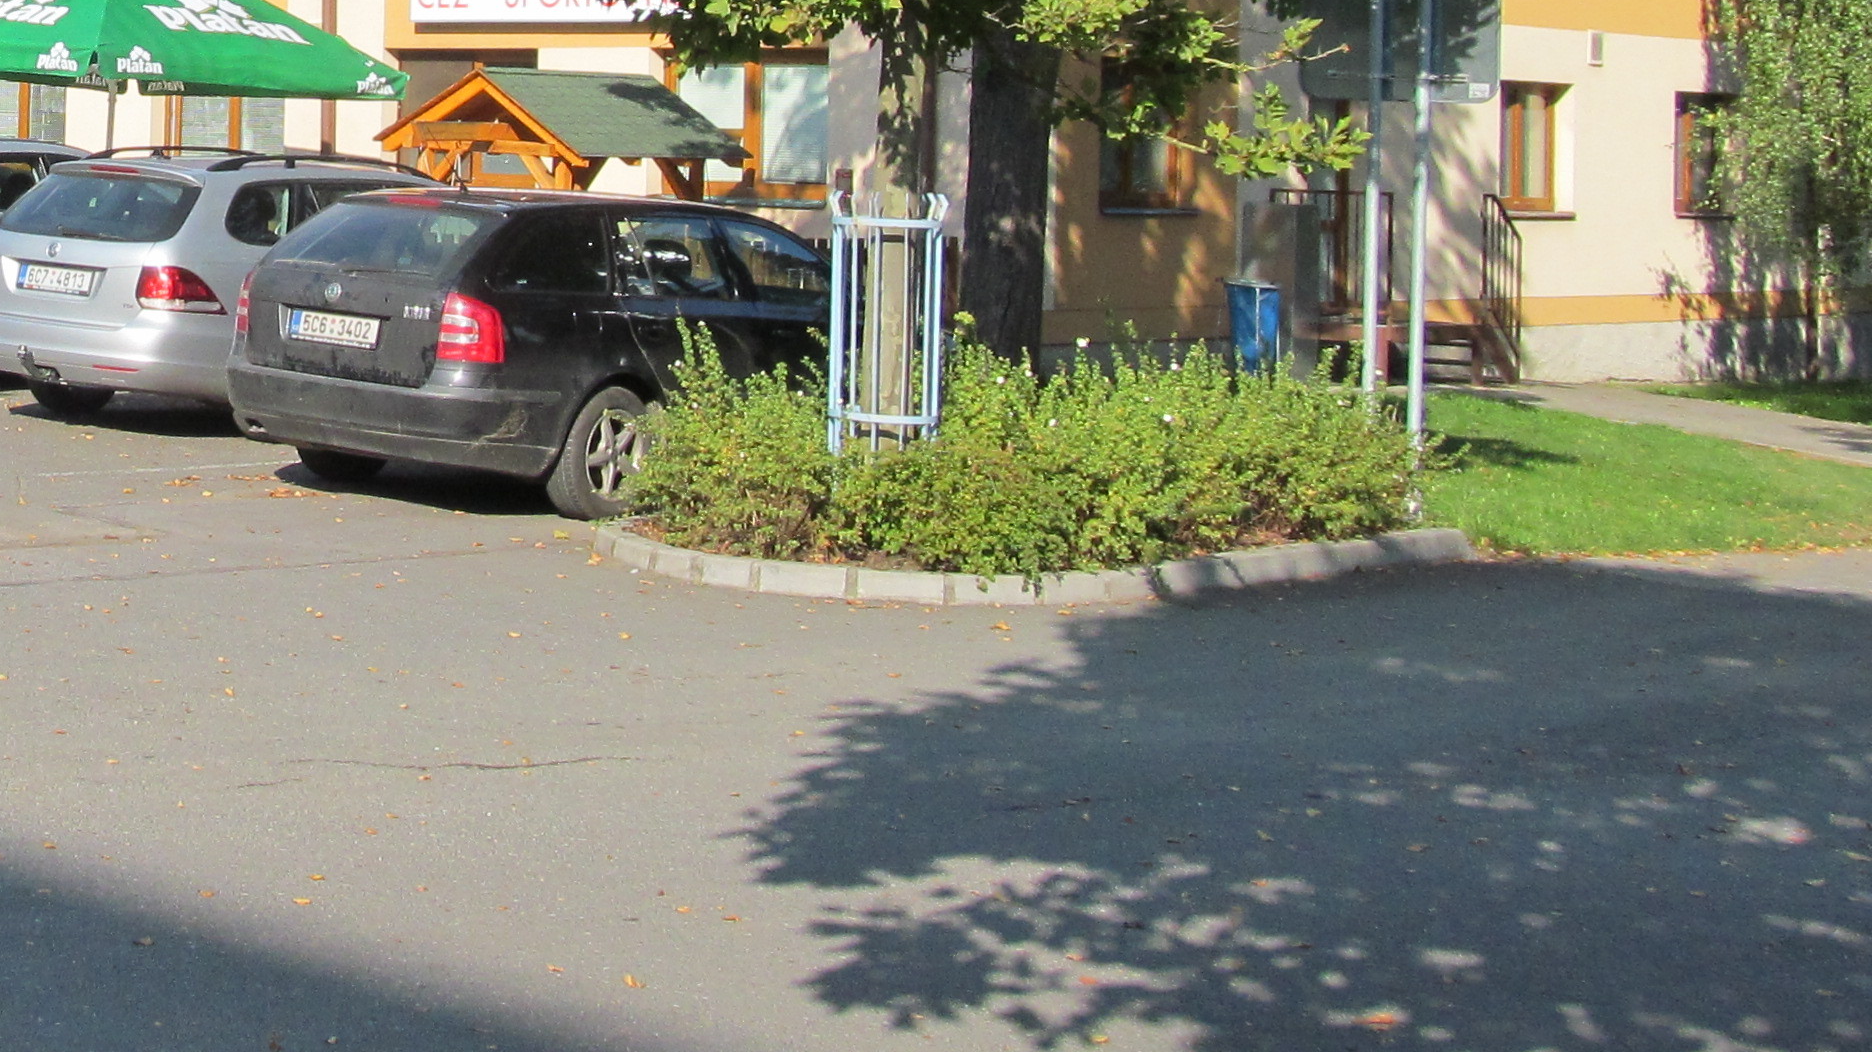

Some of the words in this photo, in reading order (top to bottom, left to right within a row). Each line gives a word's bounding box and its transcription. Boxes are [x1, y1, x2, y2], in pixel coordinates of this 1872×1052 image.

[143, 4, 315, 46] Platan
[36, 53, 78, 72] Platan
[117, 57, 164, 75] Platan
[28, 266, 49, 285] 6C7
[56, 271, 86, 289] 4813
[302, 314, 328, 334] 5C6
[337, 319, 372, 340] 3402
